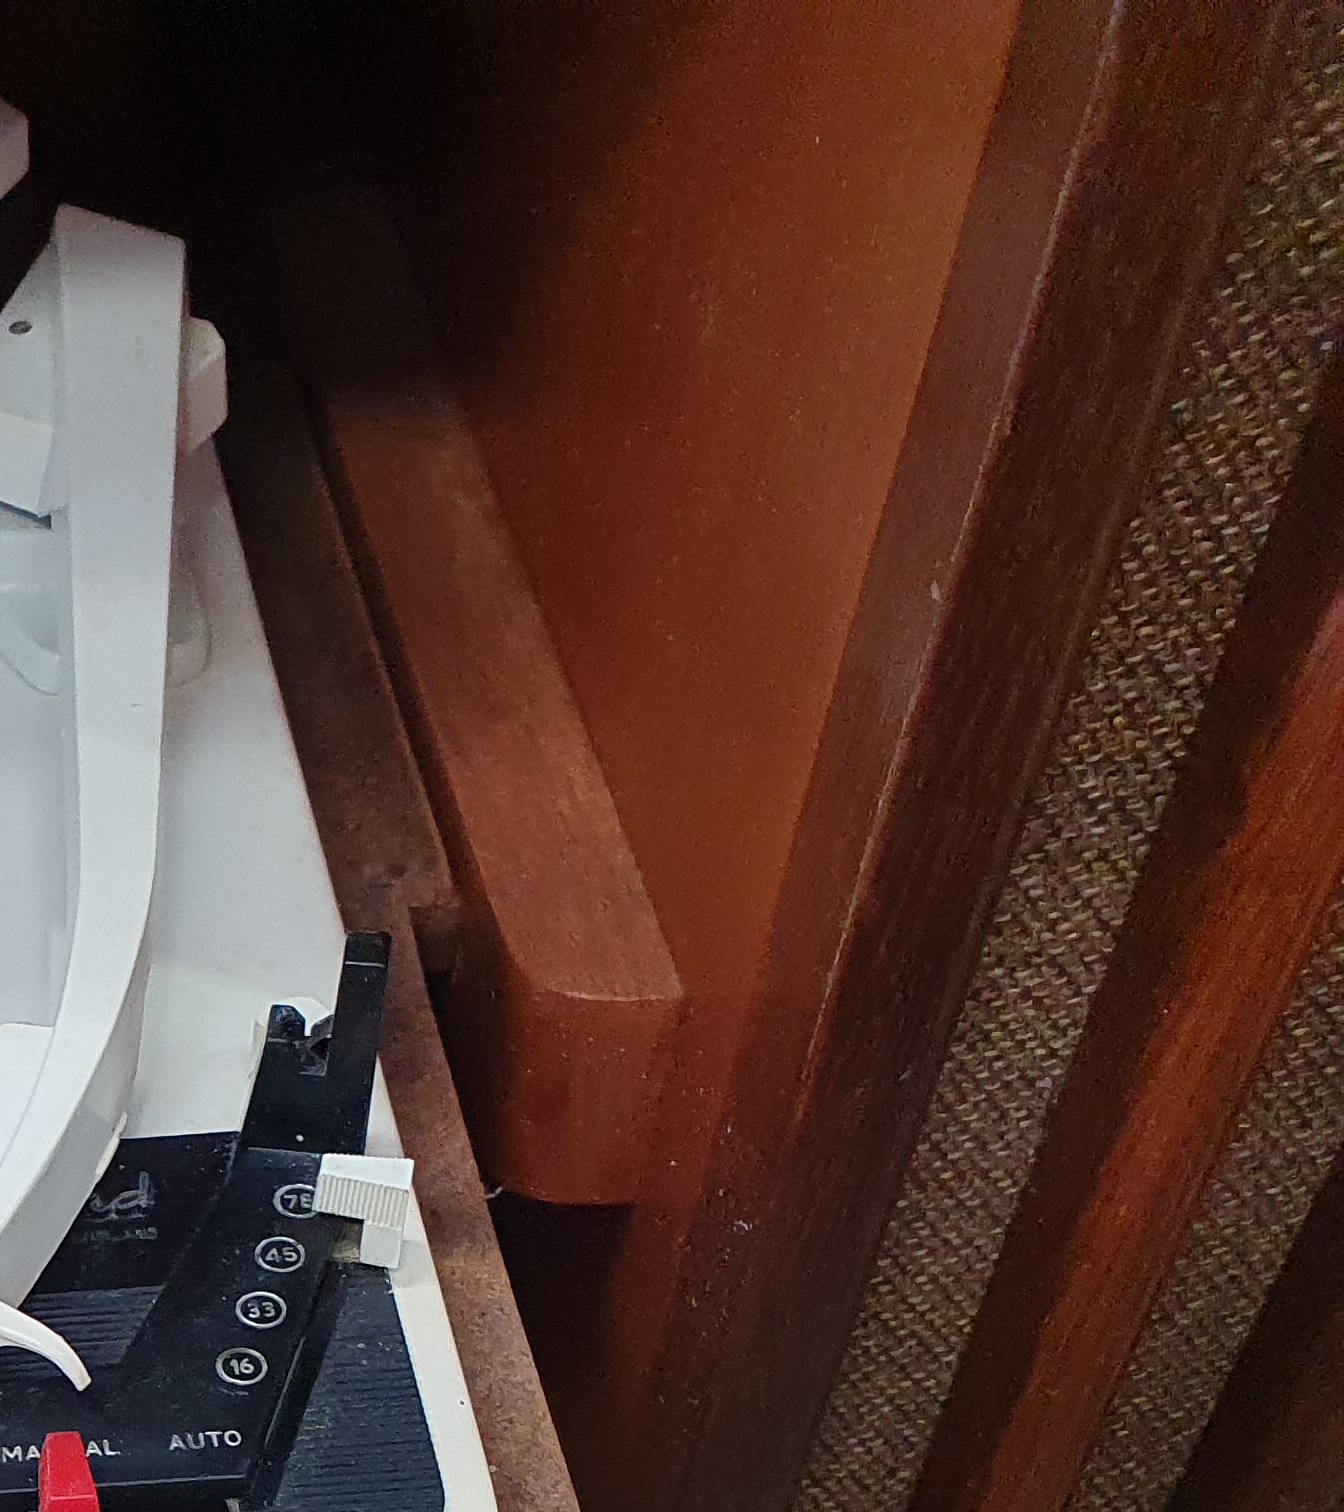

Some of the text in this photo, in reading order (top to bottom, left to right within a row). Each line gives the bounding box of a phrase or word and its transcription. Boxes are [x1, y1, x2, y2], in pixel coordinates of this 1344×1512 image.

[265, 1247, 298, 1263] 45
[247, 1301, 276, 1319] 33
[229, 1358, 255, 1376] 16
[1, 1438, 119, 1463] MAAL
[169, 1430, 243, 1452] AUTO
